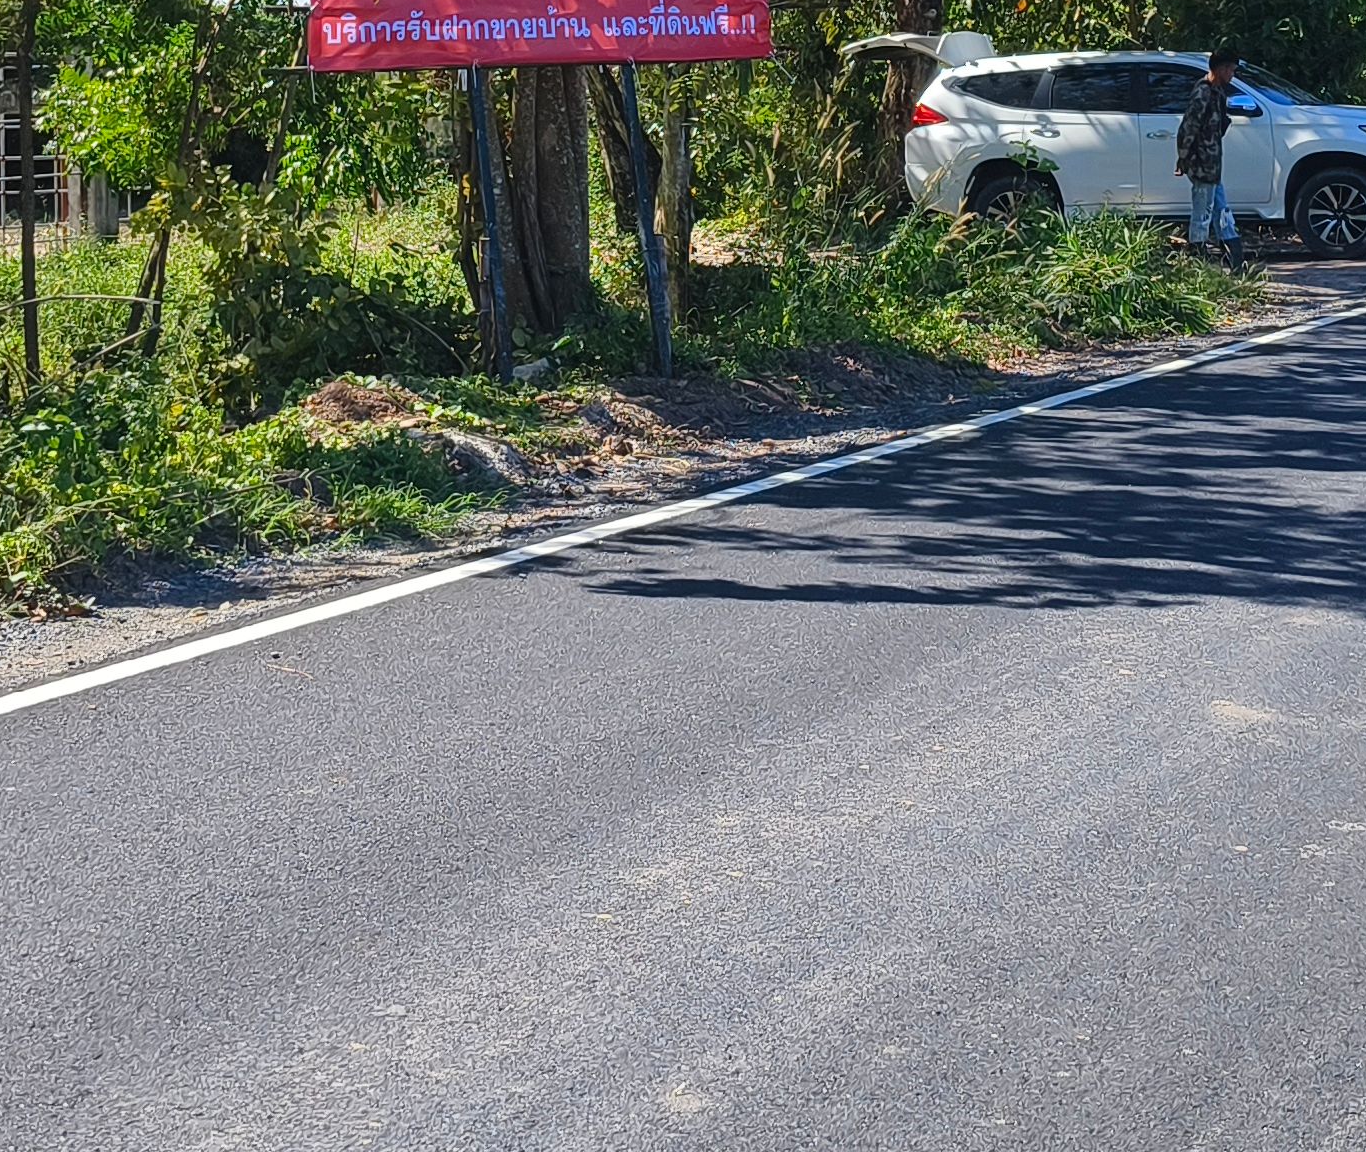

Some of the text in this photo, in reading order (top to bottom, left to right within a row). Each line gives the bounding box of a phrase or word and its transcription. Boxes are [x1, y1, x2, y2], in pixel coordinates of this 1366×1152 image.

[322, 5, 591, 45] บริการรับฝากขายบ้าน
